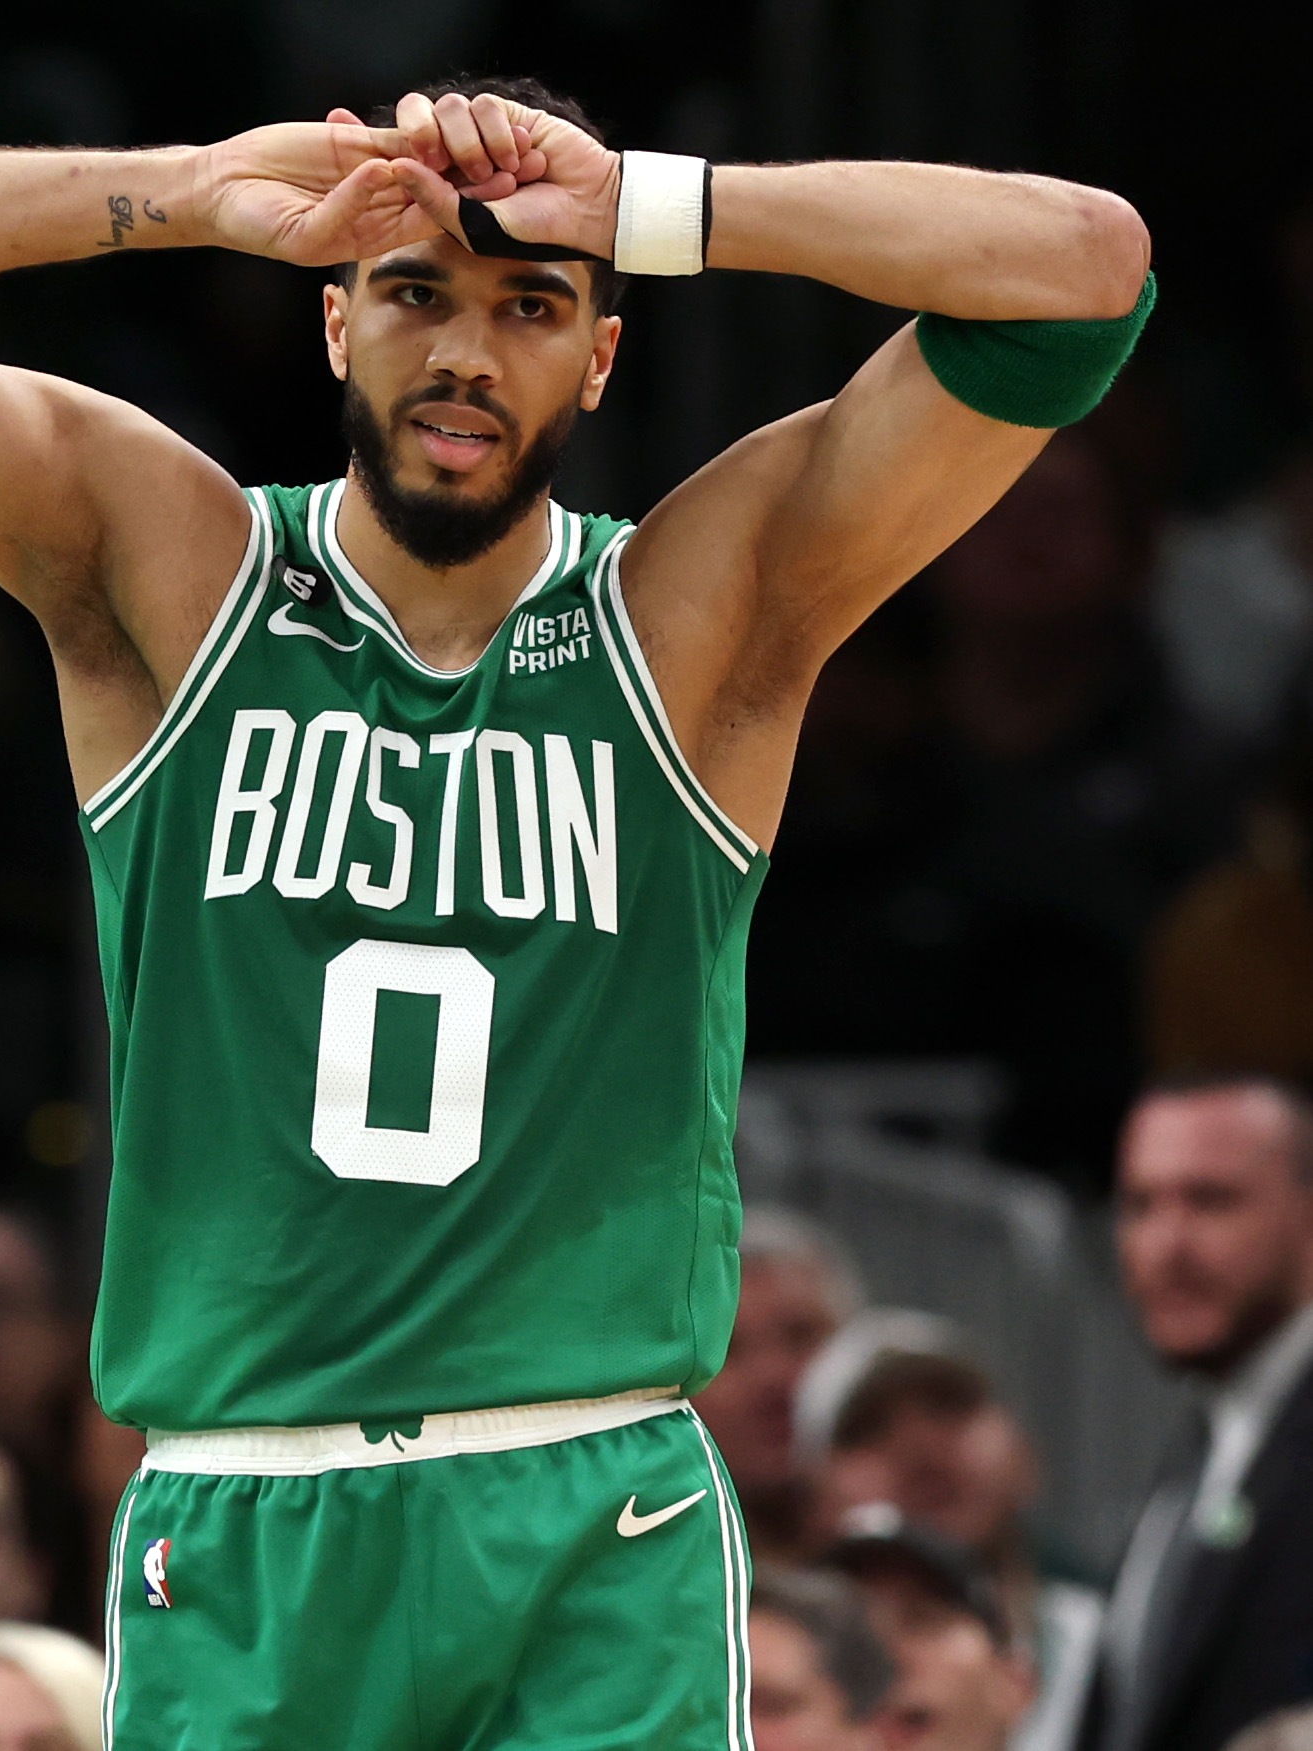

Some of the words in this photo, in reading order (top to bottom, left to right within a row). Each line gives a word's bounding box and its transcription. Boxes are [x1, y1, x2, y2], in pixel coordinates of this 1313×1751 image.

[283, 566, 317, 601] 6
[513, 607, 591, 648] VISTA
[509, 633, 592, 675] PRINT
[204, 709, 618, 935] BOSTON
[311, 938, 495, 1187] 0
